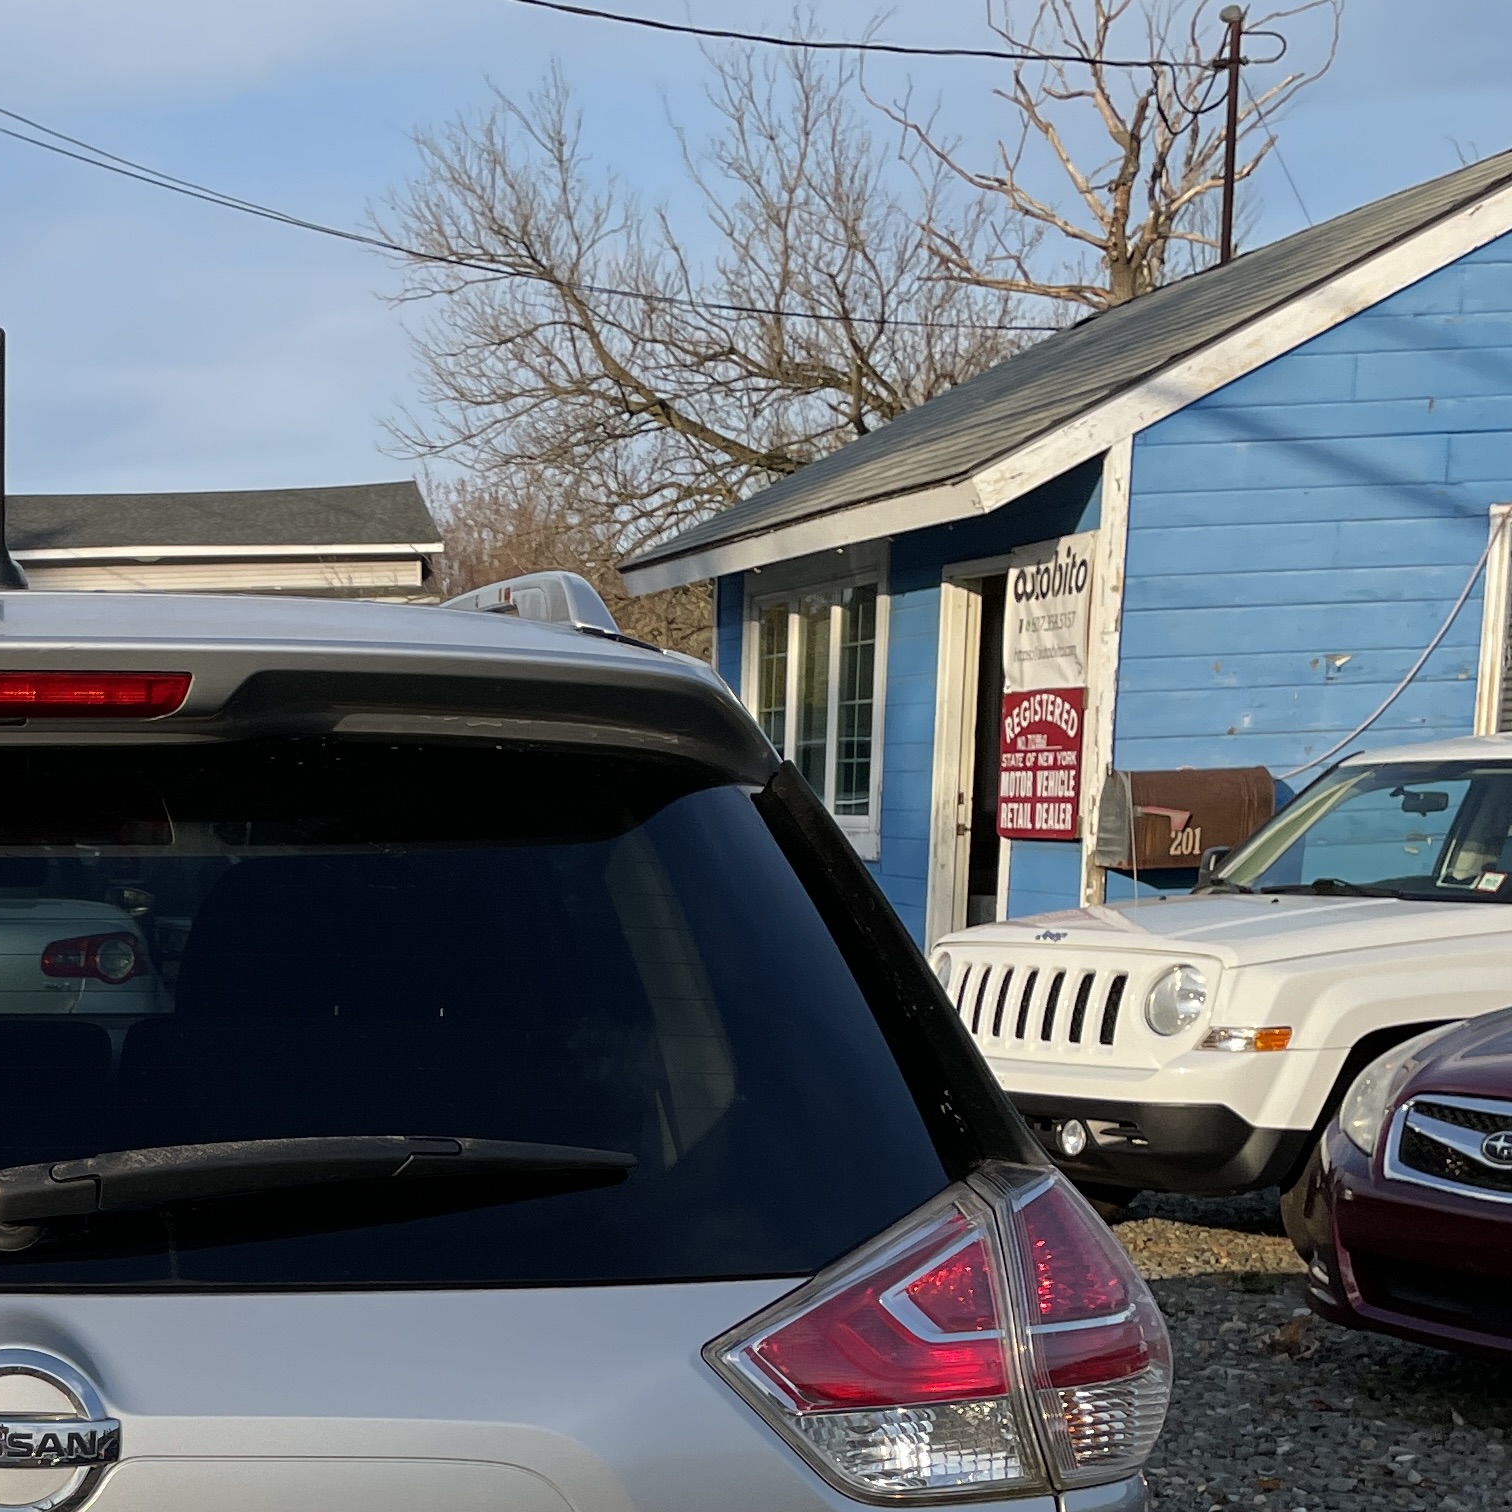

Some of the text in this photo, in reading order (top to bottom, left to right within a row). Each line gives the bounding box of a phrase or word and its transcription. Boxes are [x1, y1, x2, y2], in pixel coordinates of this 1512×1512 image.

[1005, 693, 1078, 744] REGISTERED
[1002, 751, 1077, 767] STATE OF NEW YORK
[1000, 770, 1076, 798] MOTOR VEHICLE
[1000, 802, 1072, 830] RETAIL DEALER
[1170, 827, 1201, 855] 201
